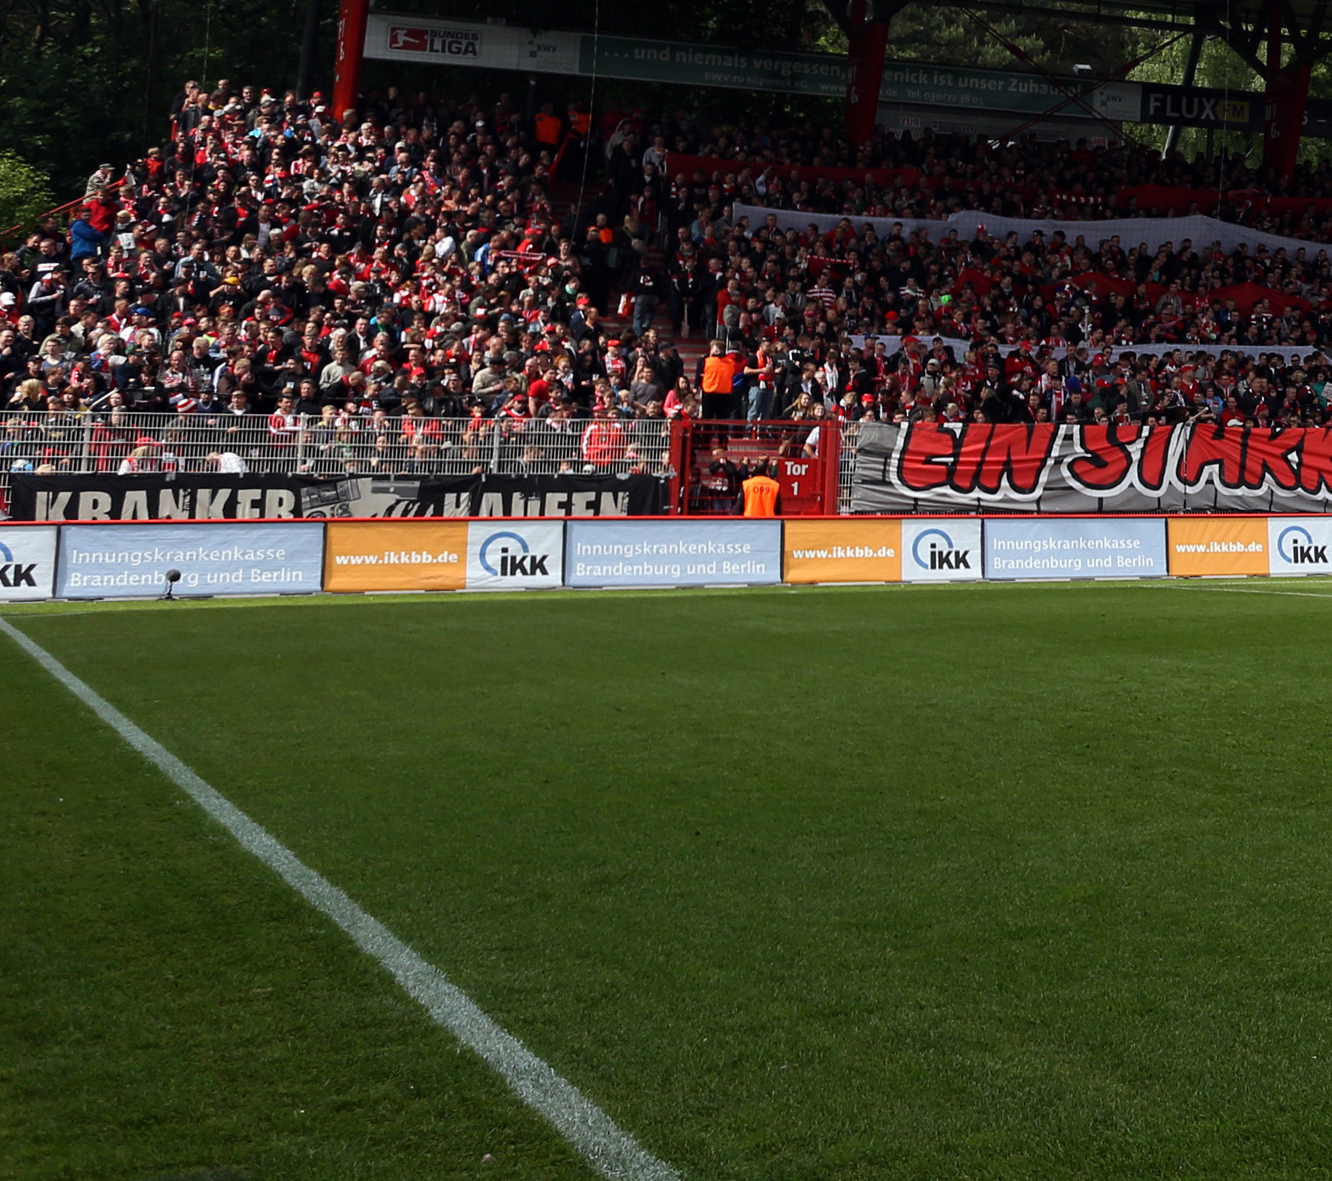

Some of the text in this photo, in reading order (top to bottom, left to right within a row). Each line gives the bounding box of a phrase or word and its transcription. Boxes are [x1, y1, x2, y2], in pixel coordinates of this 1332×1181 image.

[430, 30, 479, 41] BUNDES
[429, 38, 478, 56] LIGA
[634, 46, 671, 62] und
[676, 50, 747, 68] niemals
[934, 71, 953, 87] ist
[958, 76, 1005, 91] unser
[896, 421, 1058, 497] EIN
[785, 461, 808, 476] Tor
[791, 482, 799, 495] 1
[576, 541, 751, 561] Innungskrankenkasse
[792, 544, 895, 559] www.ikkbb.de
[992, 536, 1141, 555] Innungskrankenkasse
[1175, 540, 1263, 554] www.ikkbb.de
[71, 546, 286, 567] Innungskrankenkasse
[335, 550, 459, 566] www.ikkbb.de
[992, 553, 1154, 572] Brandenburg und Berlin
[207, 570, 243, 585] und
[250, 569, 303, 584] Berlin
[575, 559, 766, 579] Brandenburg und Berlin
